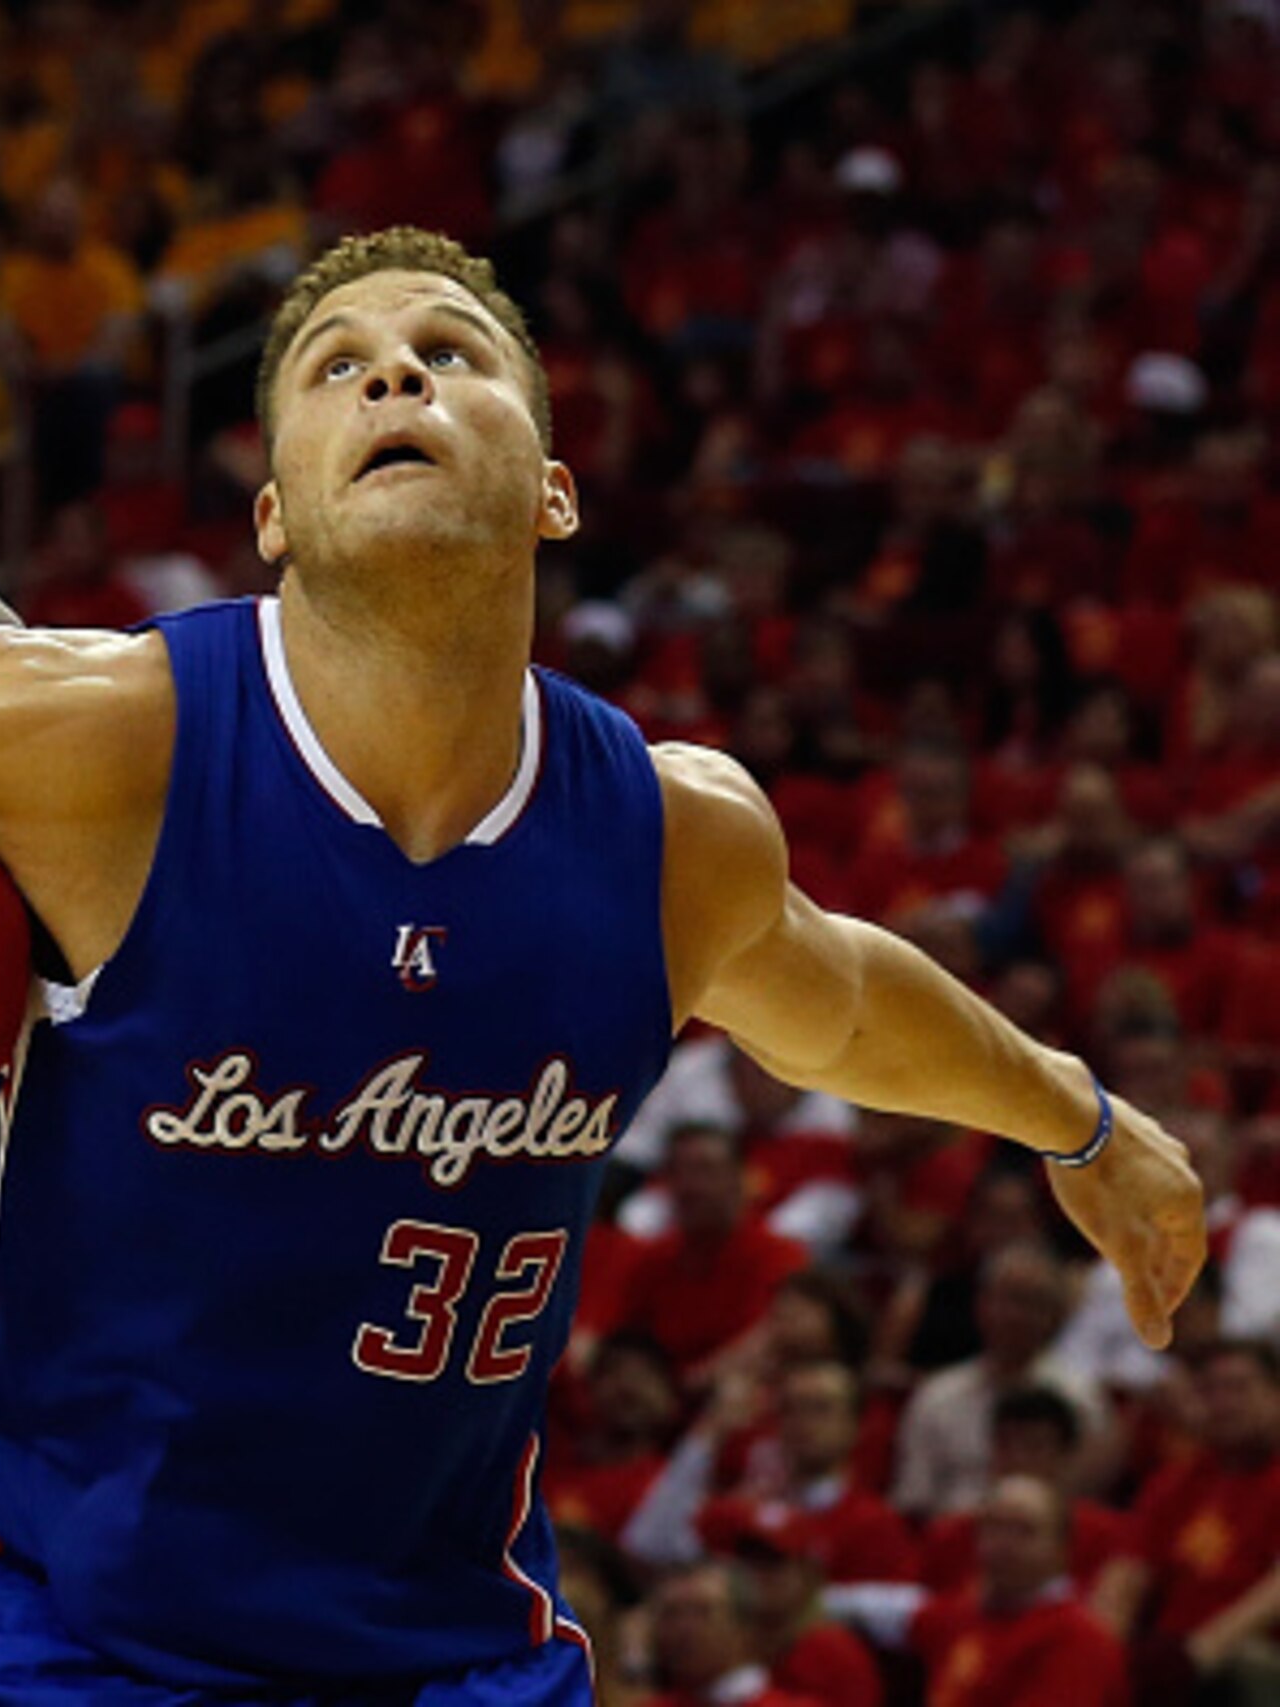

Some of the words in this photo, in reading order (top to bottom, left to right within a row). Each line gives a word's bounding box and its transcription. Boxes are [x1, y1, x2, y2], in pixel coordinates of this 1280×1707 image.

[147, 1053, 307, 1151] Los
[319, 1054, 618, 1186] Angeles
[352, 1219, 568, 1385] 32
